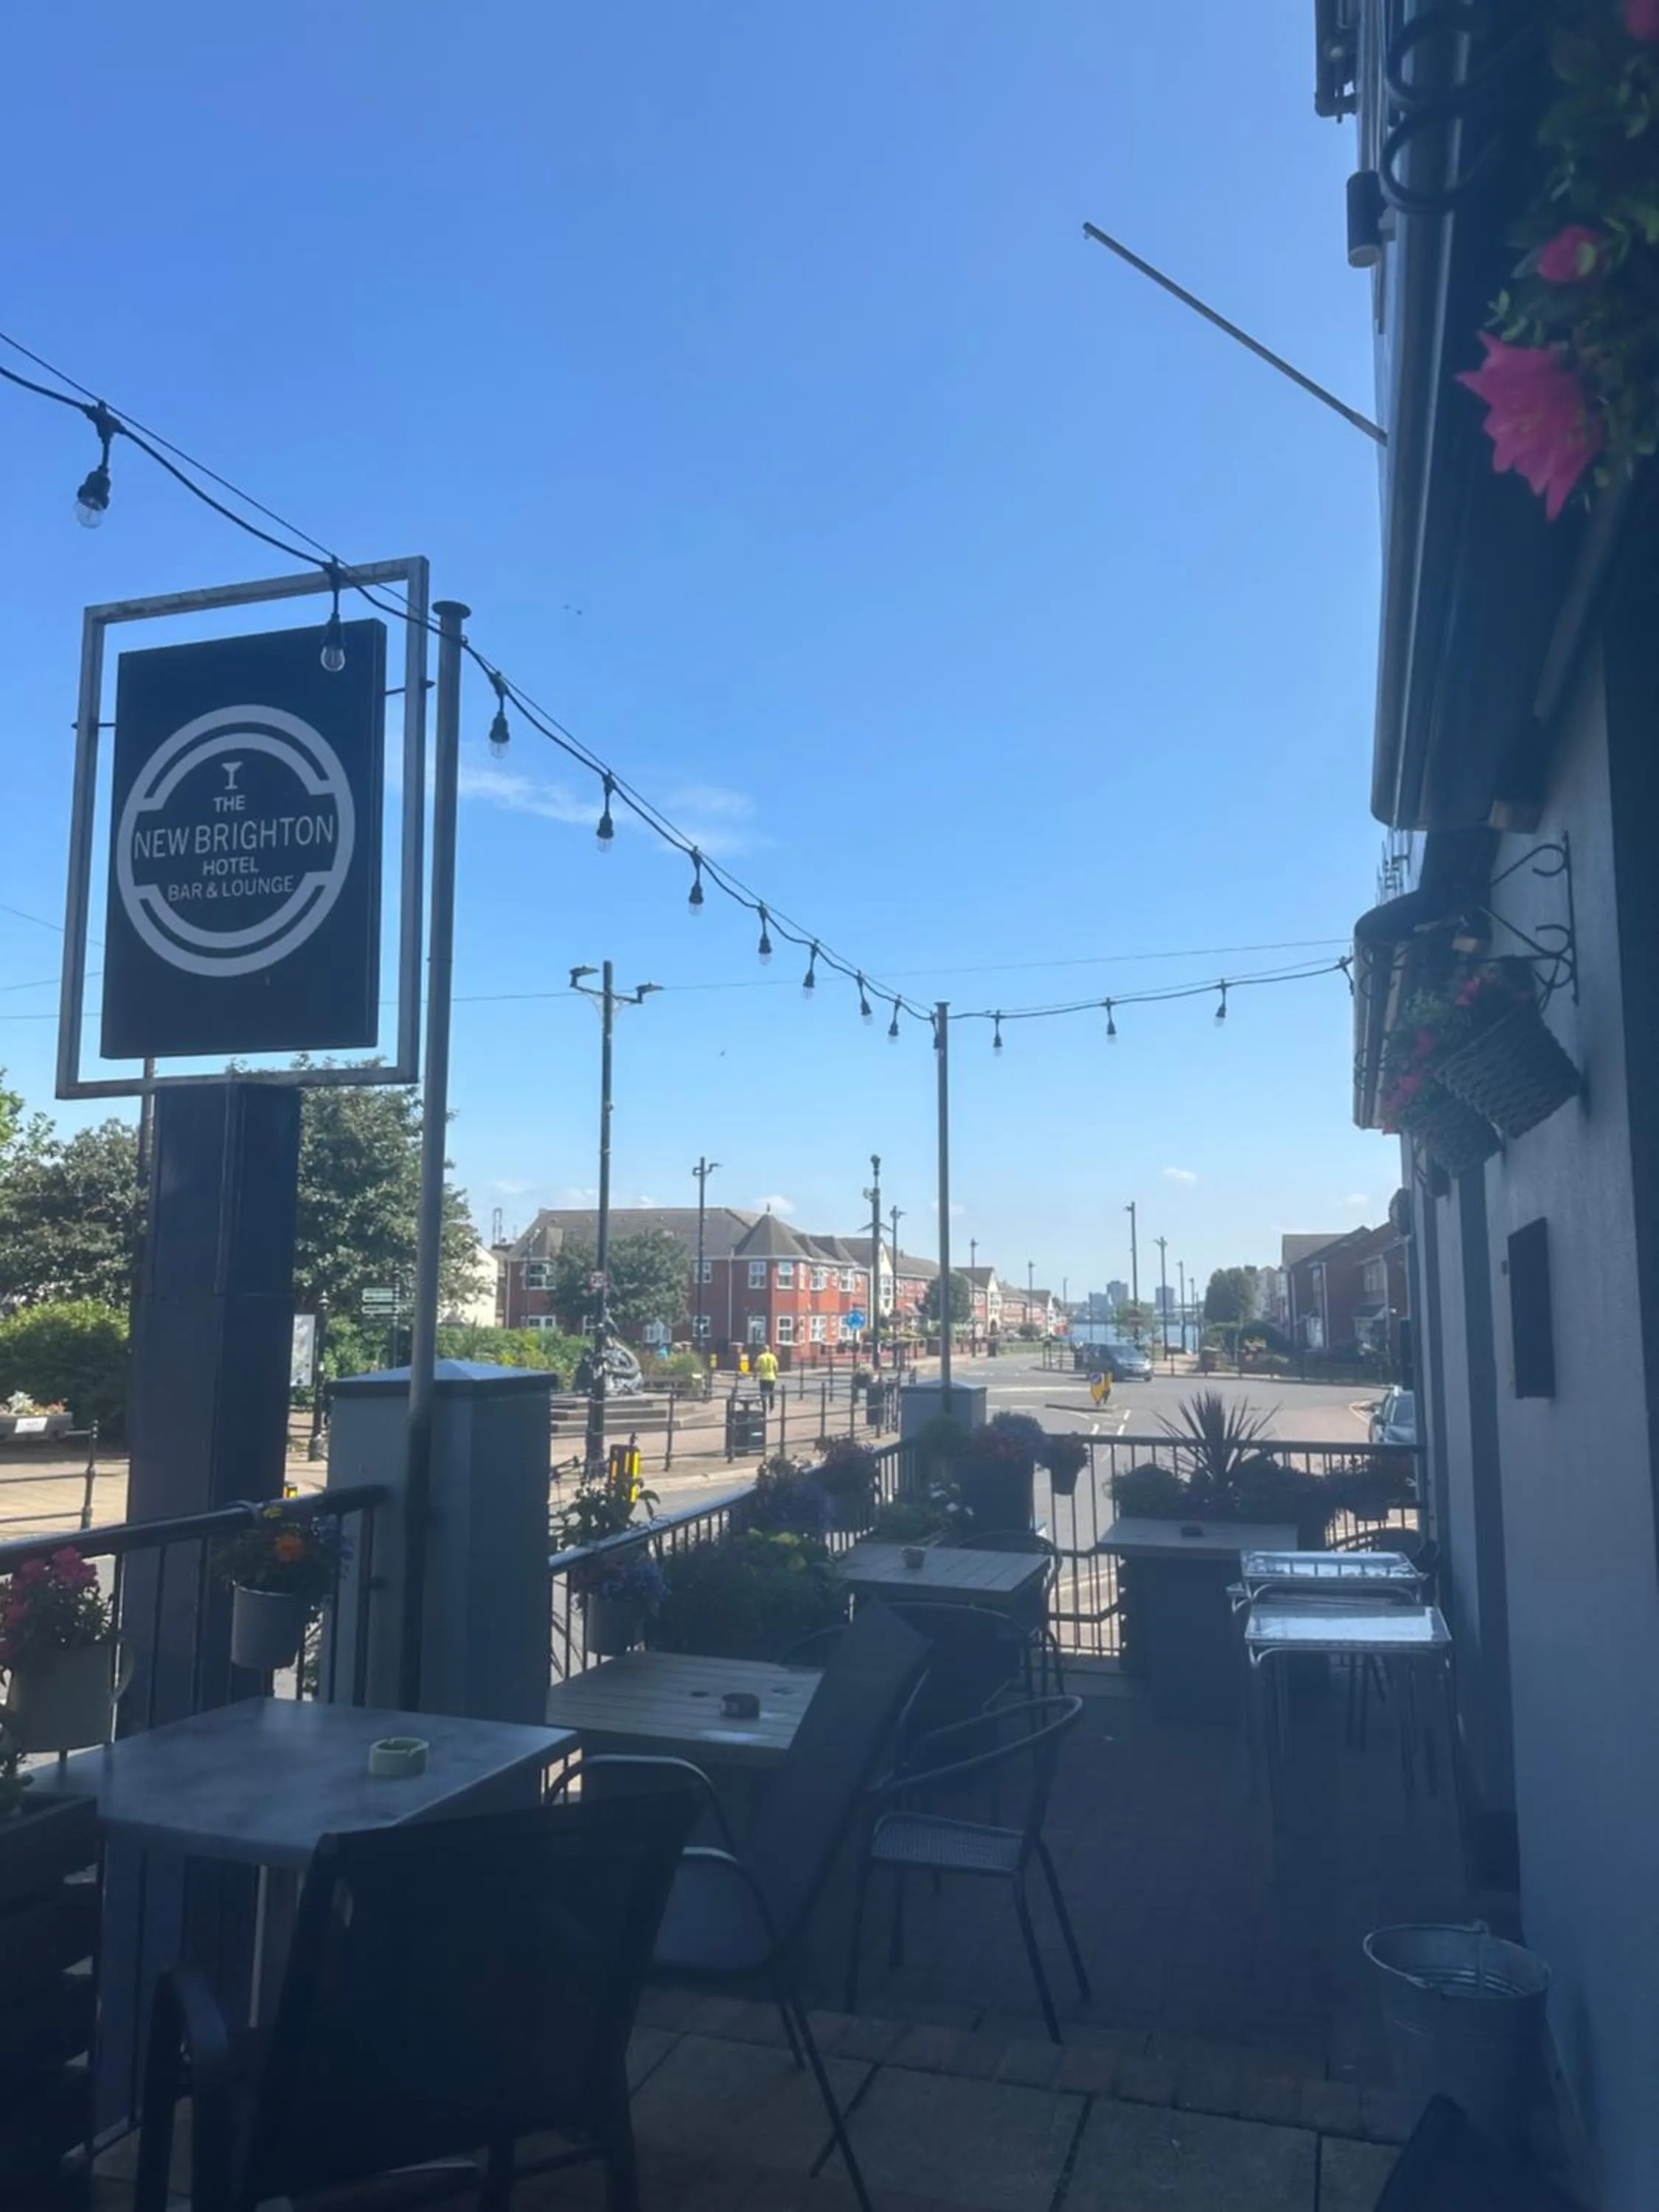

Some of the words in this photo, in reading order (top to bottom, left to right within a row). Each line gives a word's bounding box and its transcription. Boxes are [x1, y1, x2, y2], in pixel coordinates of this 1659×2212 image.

[212, 795, 246, 812] THE
[133, 826, 189, 859] NEW
[195, 814, 333, 854] BRIGHTON
[202, 857, 260, 876] HOTEL
[167, 883, 203, 902] BAR
[206, 881, 218, 899] &
[221, 875, 294, 897] LOUNGE
